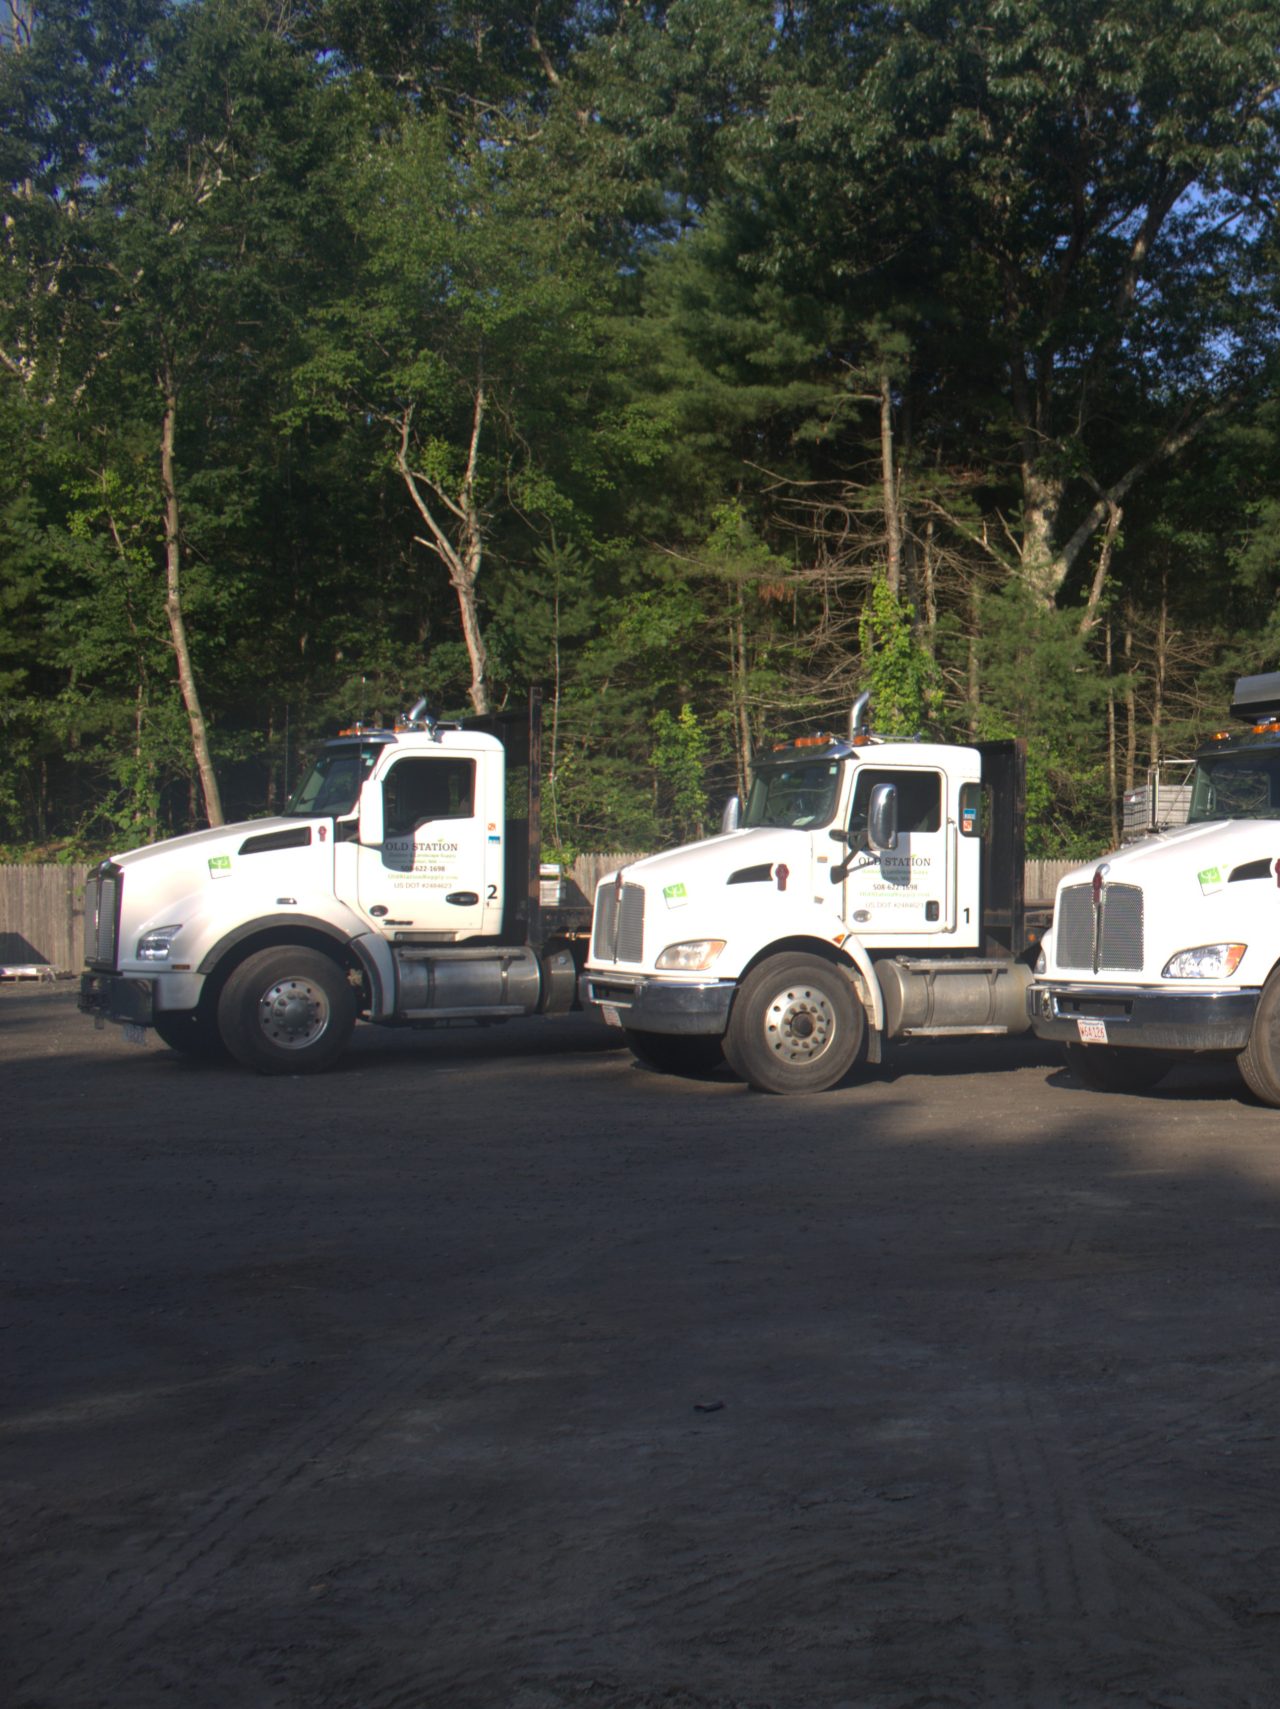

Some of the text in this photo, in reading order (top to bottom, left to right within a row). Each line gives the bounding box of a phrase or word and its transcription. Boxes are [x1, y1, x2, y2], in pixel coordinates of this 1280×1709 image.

[385, 842, 458, 851] OLD STATION
[885, 857, 931, 866] STATION
[487, 884, 498, 900] 2
[963, 907, 970, 924] 1
